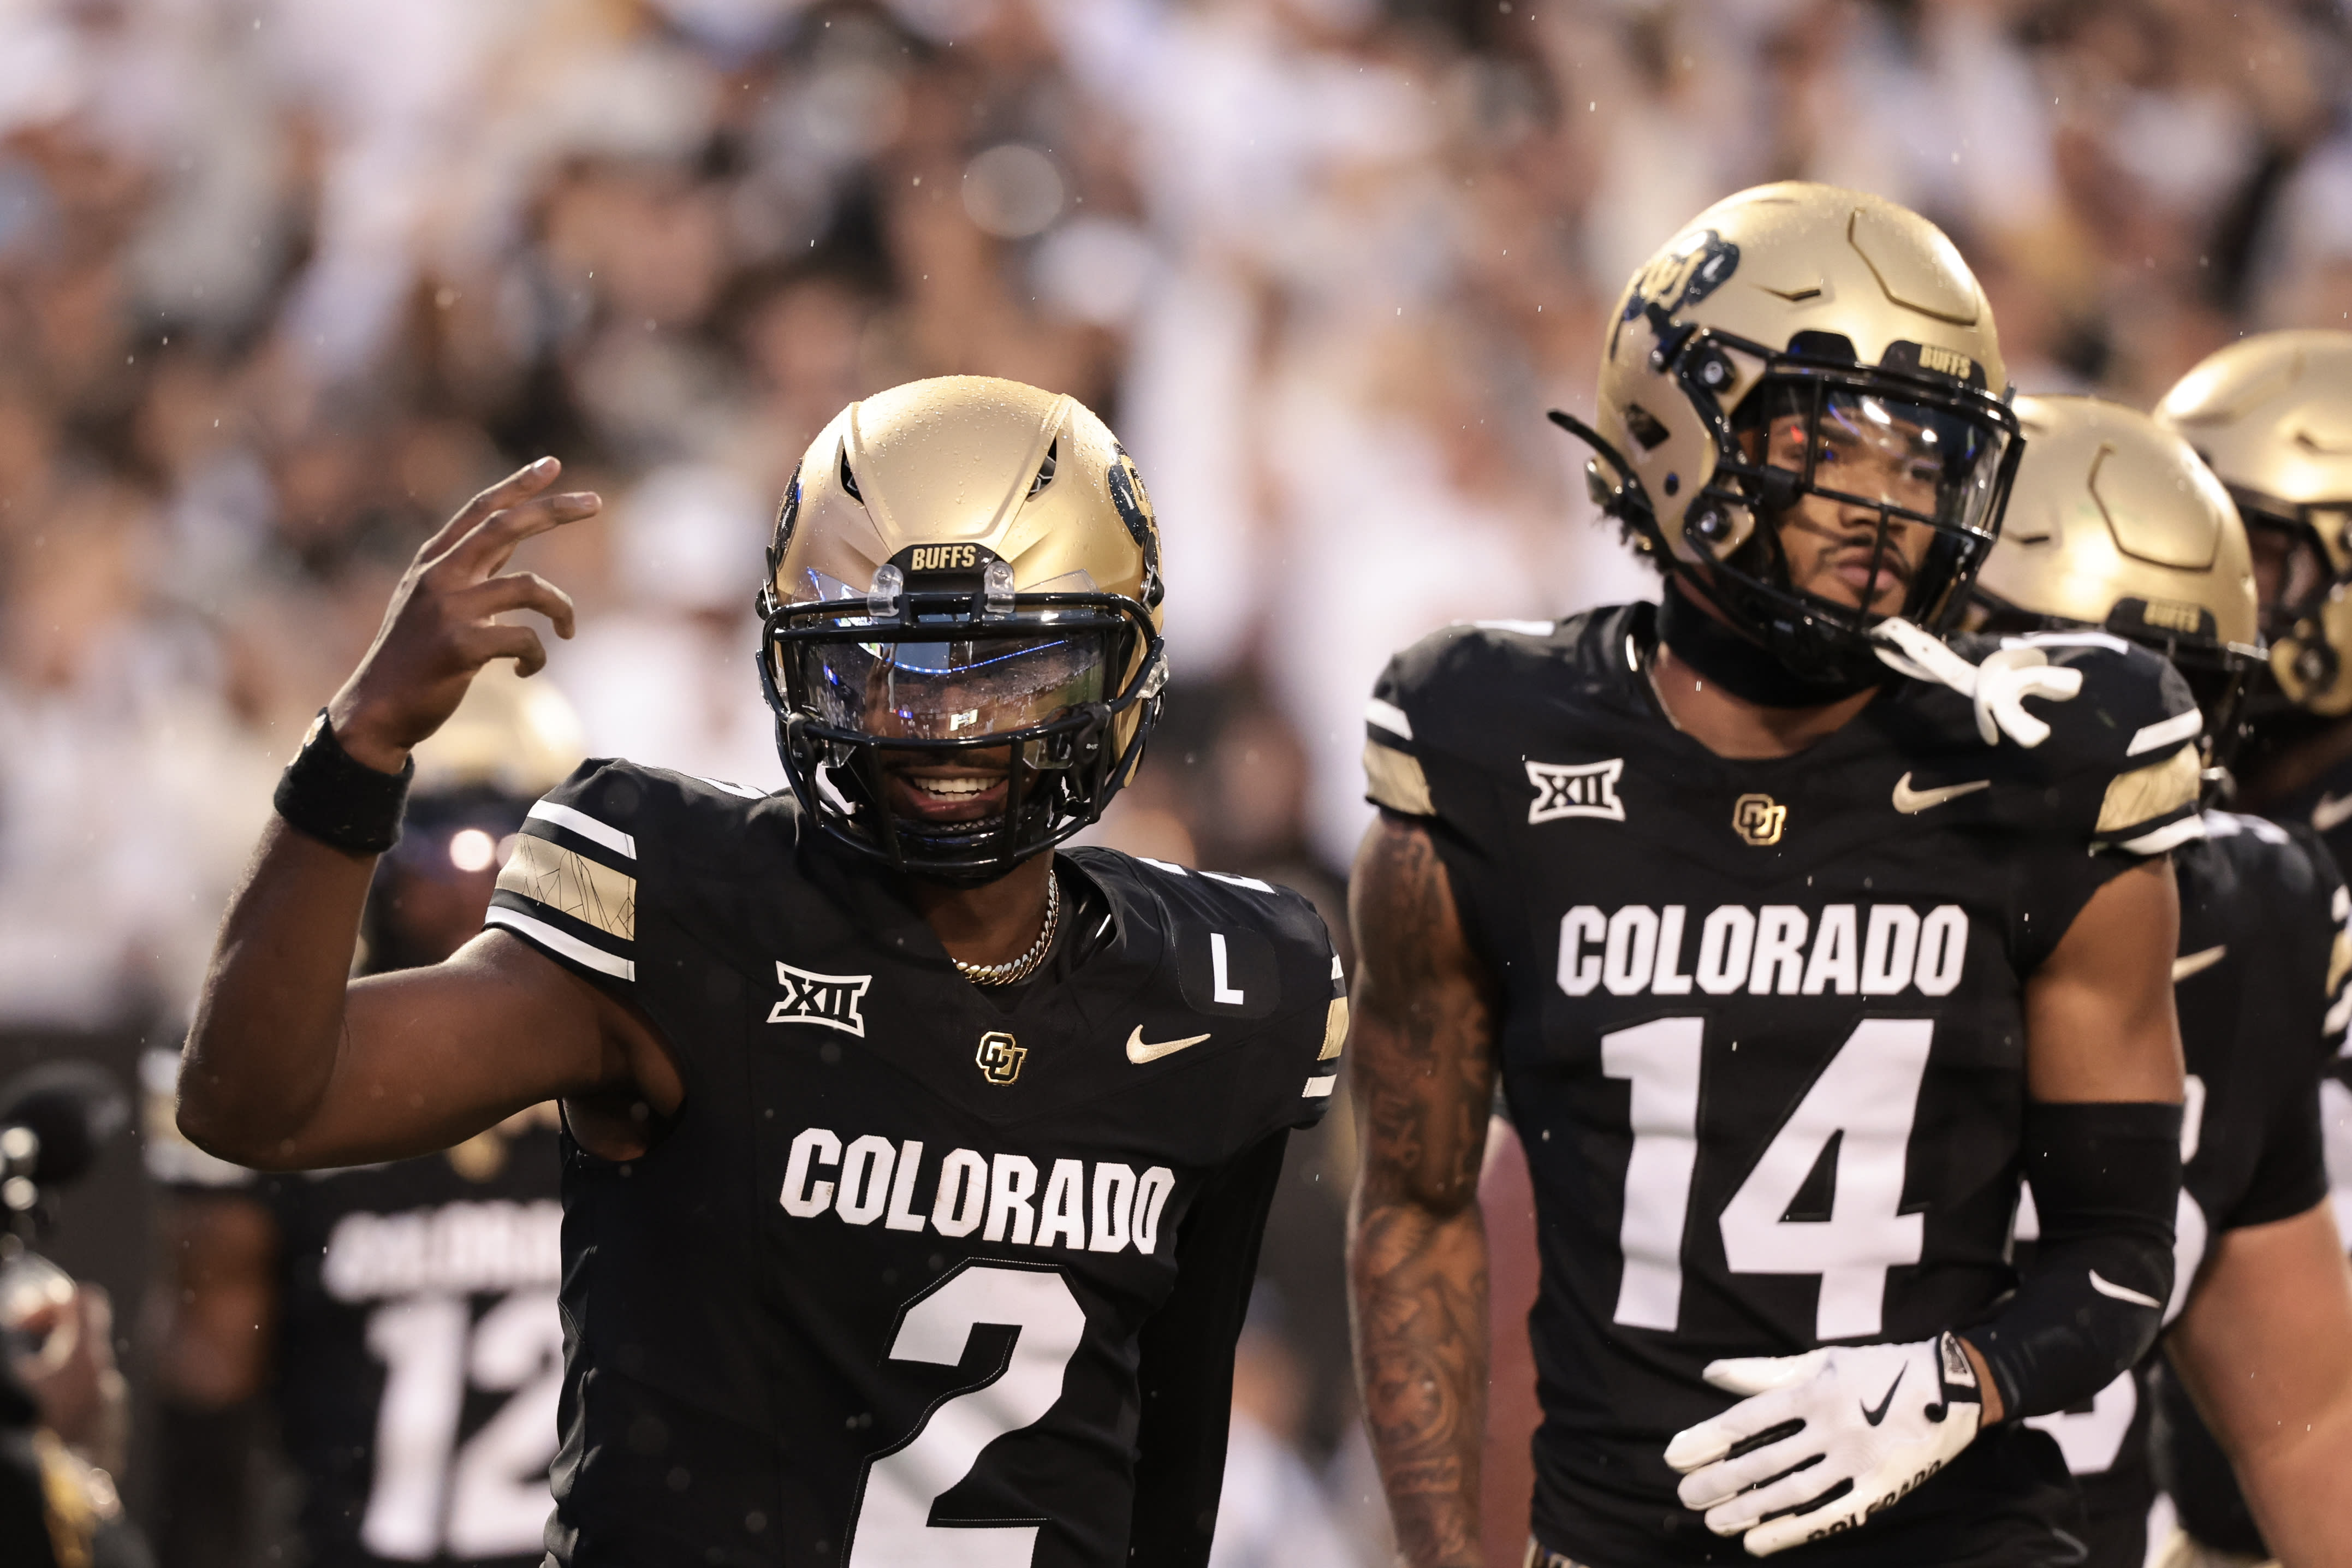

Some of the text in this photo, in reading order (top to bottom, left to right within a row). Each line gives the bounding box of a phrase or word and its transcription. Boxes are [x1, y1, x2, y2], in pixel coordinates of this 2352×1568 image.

[1918, 346, 1970, 379] BUFFS
[911, 545, 976, 571] BUFFS
[1534, 765, 1615, 816] XII
[1732, 793, 1787, 845] CU
[1210, 933, 1244, 1005] L
[1557, 904, 1969, 996] COLORADO
[775, 967, 867, 1032] XII
[976, 1031, 1028, 1084] CU
[780, 1127, 1175, 1255] COLORADO
[1601, 1017, 1935, 1340] 14
[361, 1302, 561, 1559] 12
[848, 1266, 1086, 1568] 2
